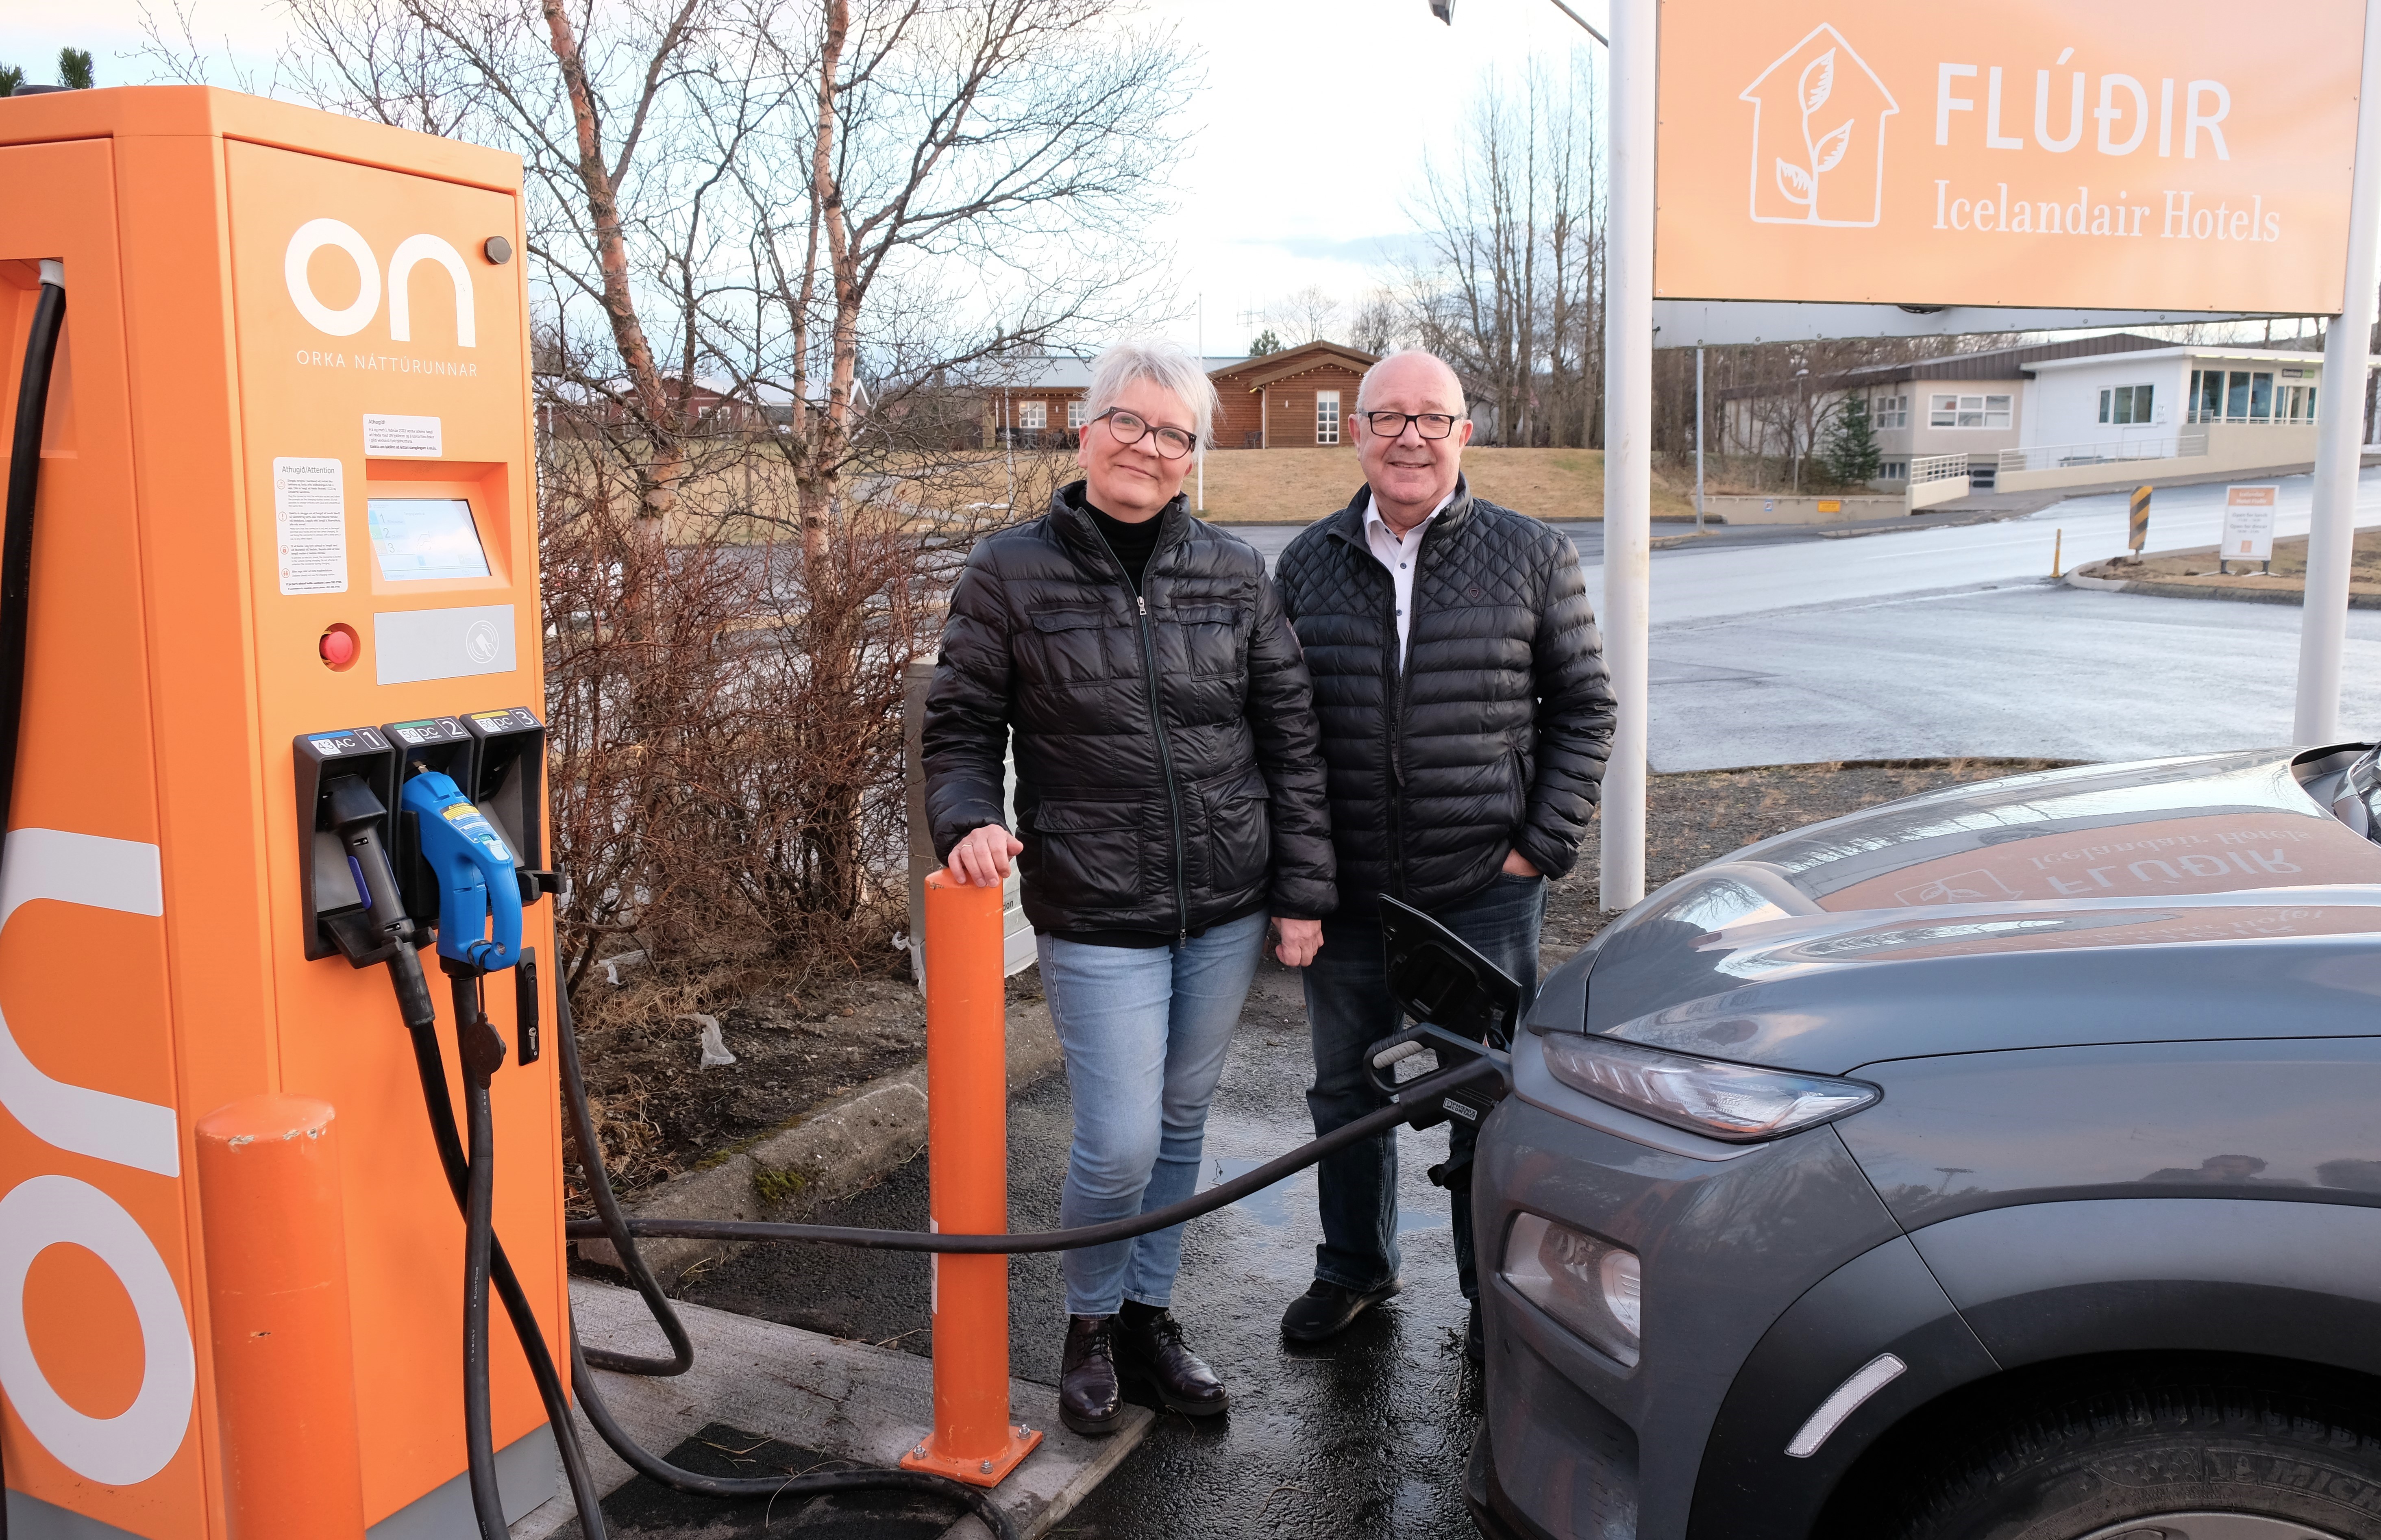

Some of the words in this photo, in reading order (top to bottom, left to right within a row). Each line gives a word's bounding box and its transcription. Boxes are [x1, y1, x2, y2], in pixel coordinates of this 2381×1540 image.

[1934, 47, 2232, 161] FLÚÐIR
[1932, 180, 2149, 237] Icelandair
[2161, 190, 2281, 244] Hotels
[284, 218, 476, 348] on
[297, 350, 346, 368] ORKA
[355, 353, 477, 377] NÁTTÚRUNNAR
[282, 466, 335, 474] Athugið/Attention
[380, 513, 385, 523] 1
[383, 528, 391, 538] 2
[388, 543, 395, 553] 3
[479, 720, 495, 728] 50
[493, 717, 513, 726] DC
[515, 711, 534, 725] 3
[402, 730, 418, 739] 50
[416, 727, 438, 737] DC
[442, 721, 464, 735] 2
[318, 741, 334, 750] 43
[335, 738, 356, 748] AC
[363, 731, 381, 746] 1
[1452, 1107, 1476, 1118] CONTACT
